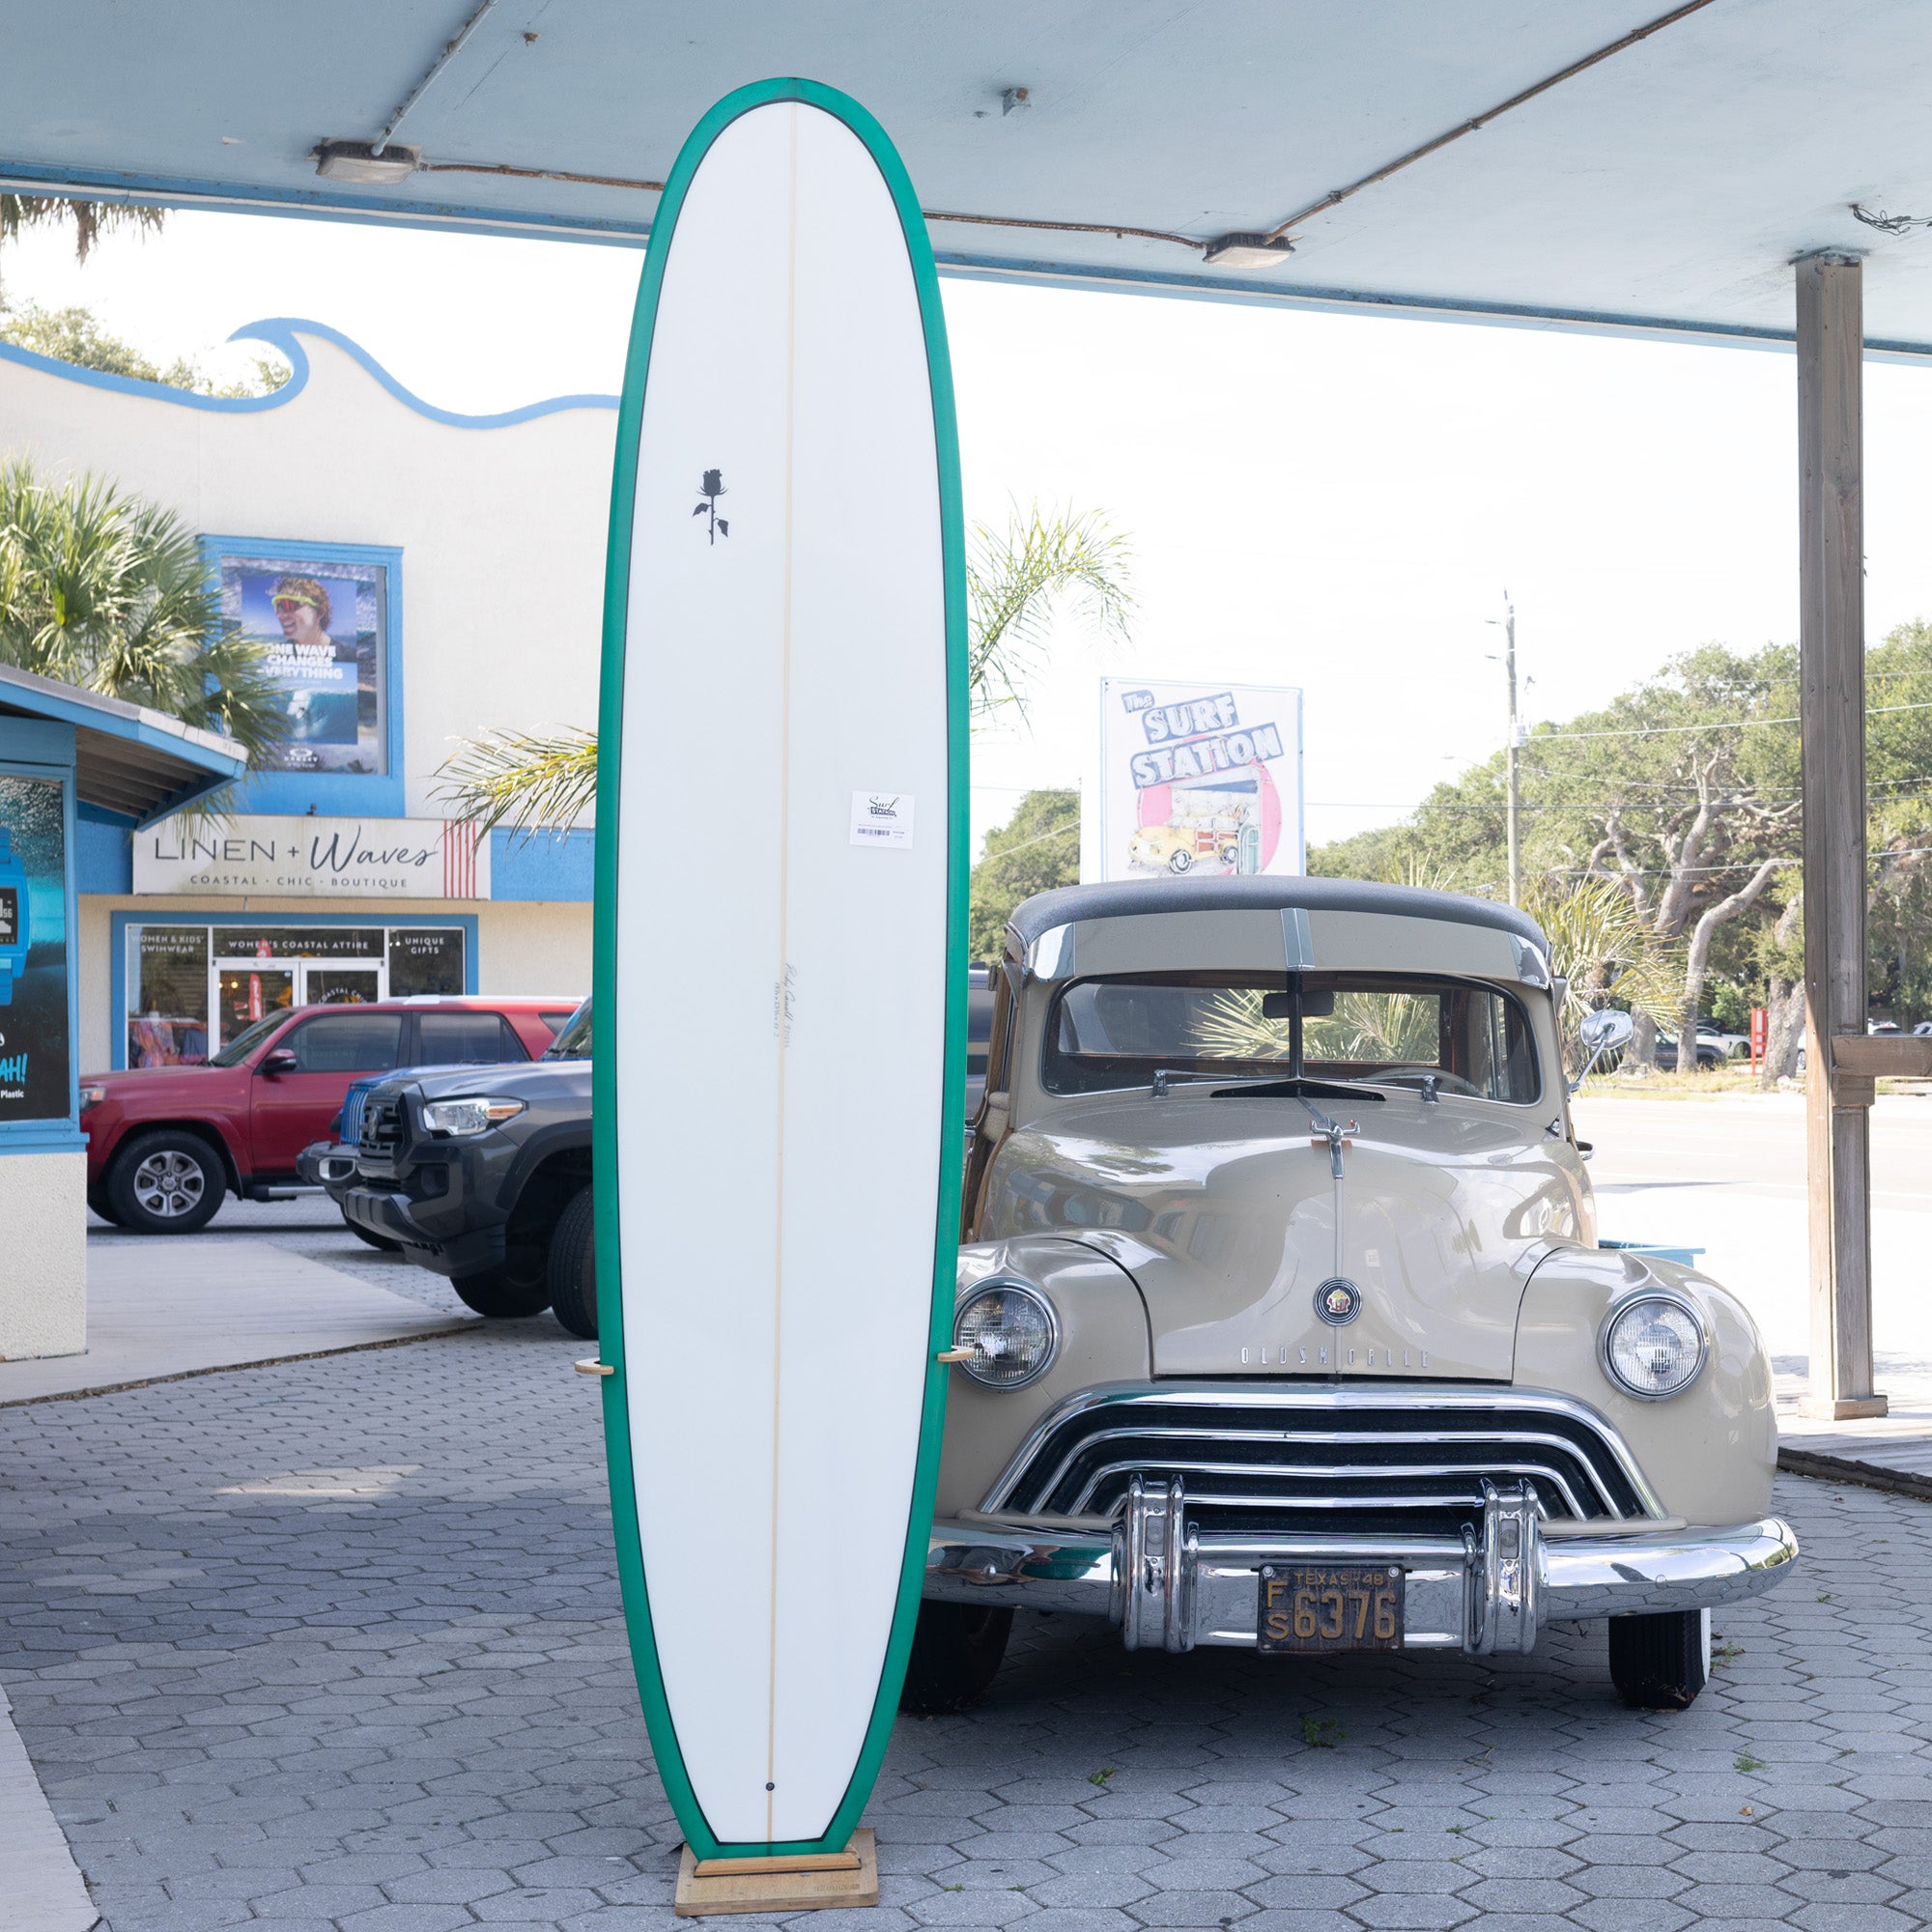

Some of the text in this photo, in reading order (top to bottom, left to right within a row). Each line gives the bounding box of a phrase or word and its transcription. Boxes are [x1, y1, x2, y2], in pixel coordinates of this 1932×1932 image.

[296, 644, 336, 657] WAVE
[267, 654, 333, 668] CHANGES
[1123, 694, 1154, 709] The
[1145, 696, 1237, 743] SURF
[1132, 725, 1281, 787] STATION
[155, 838, 275, 862] LINEN
[310, 824, 439, 873] Waves
[190, 875, 408, 890] COASTAL CHIC BOUTIQUE
[131, 934, 167, 944] WOMEN
[228, 939, 369, 950] WOMEN'S COASTAL ATTIRE
[405, 937, 444, 947] UNIQUE
[141, 945, 194, 954] SWIMWEAR
[411, 947, 440, 955] GIFTS
[0, 1089, 24, 1098] Plastic
[1240, 1346, 1430, 1368] OLDSMOBILE
[1266, 1580, 1288, 1607] F
[1293, 1591, 1397, 1639] 6376
[1265, 1613, 1290, 1640] S
